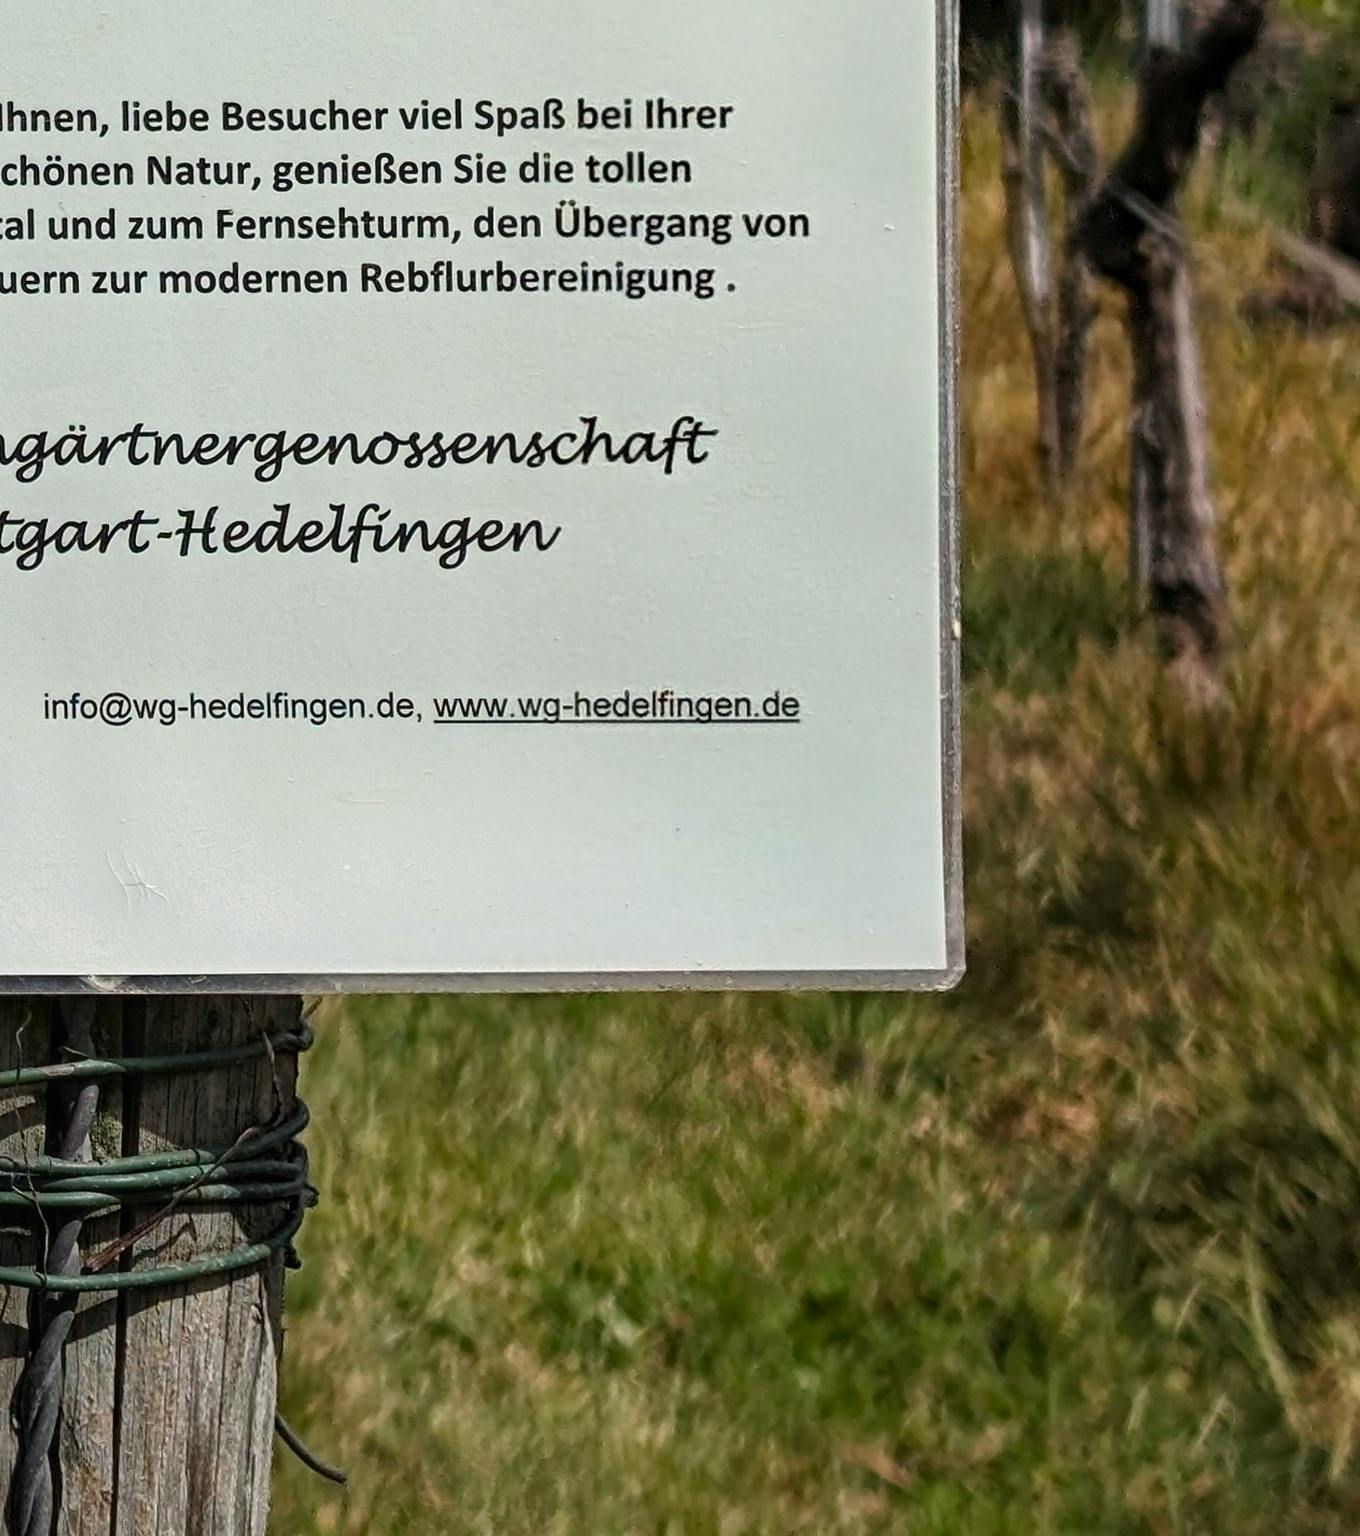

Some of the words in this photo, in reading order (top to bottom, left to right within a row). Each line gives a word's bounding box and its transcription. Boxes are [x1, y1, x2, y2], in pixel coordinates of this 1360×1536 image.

[121, 99, 210, 133] liebe
[221, 98, 389, 132] Besucher
[398, 97, 463, 131] viel
[474, 97, 566, 132] Spaß
[576, 97, 633, 131] bei
[645, 96, 735, 130] Ihrer
[146, 155, 262, 191] Natur,
[271, 151, 442, 190] genießen
[453, 152, 507, 185] Sie
[518, 151, 575, 184] die
[584, 150, 693, 184] tollen
[47, 207, 116, 241] und
[127, 215, 204, 241] zum
[216, 206, 462, 245] Fernsehturm,
[473, 205, 542, 239] den
[554, 199, 734, 244] Übergang
[741, 213, 810, 238] von
[91, 270, 149, 295] zur
[158, 260, 348, 295] modernen
[360, 259, 716, 298] Rebflurbereinigung
[43, 691, 423, 727] info@wg-hedelfingen.de,
[432, 689, 801, 725] www.wg-hedelfingen.de
